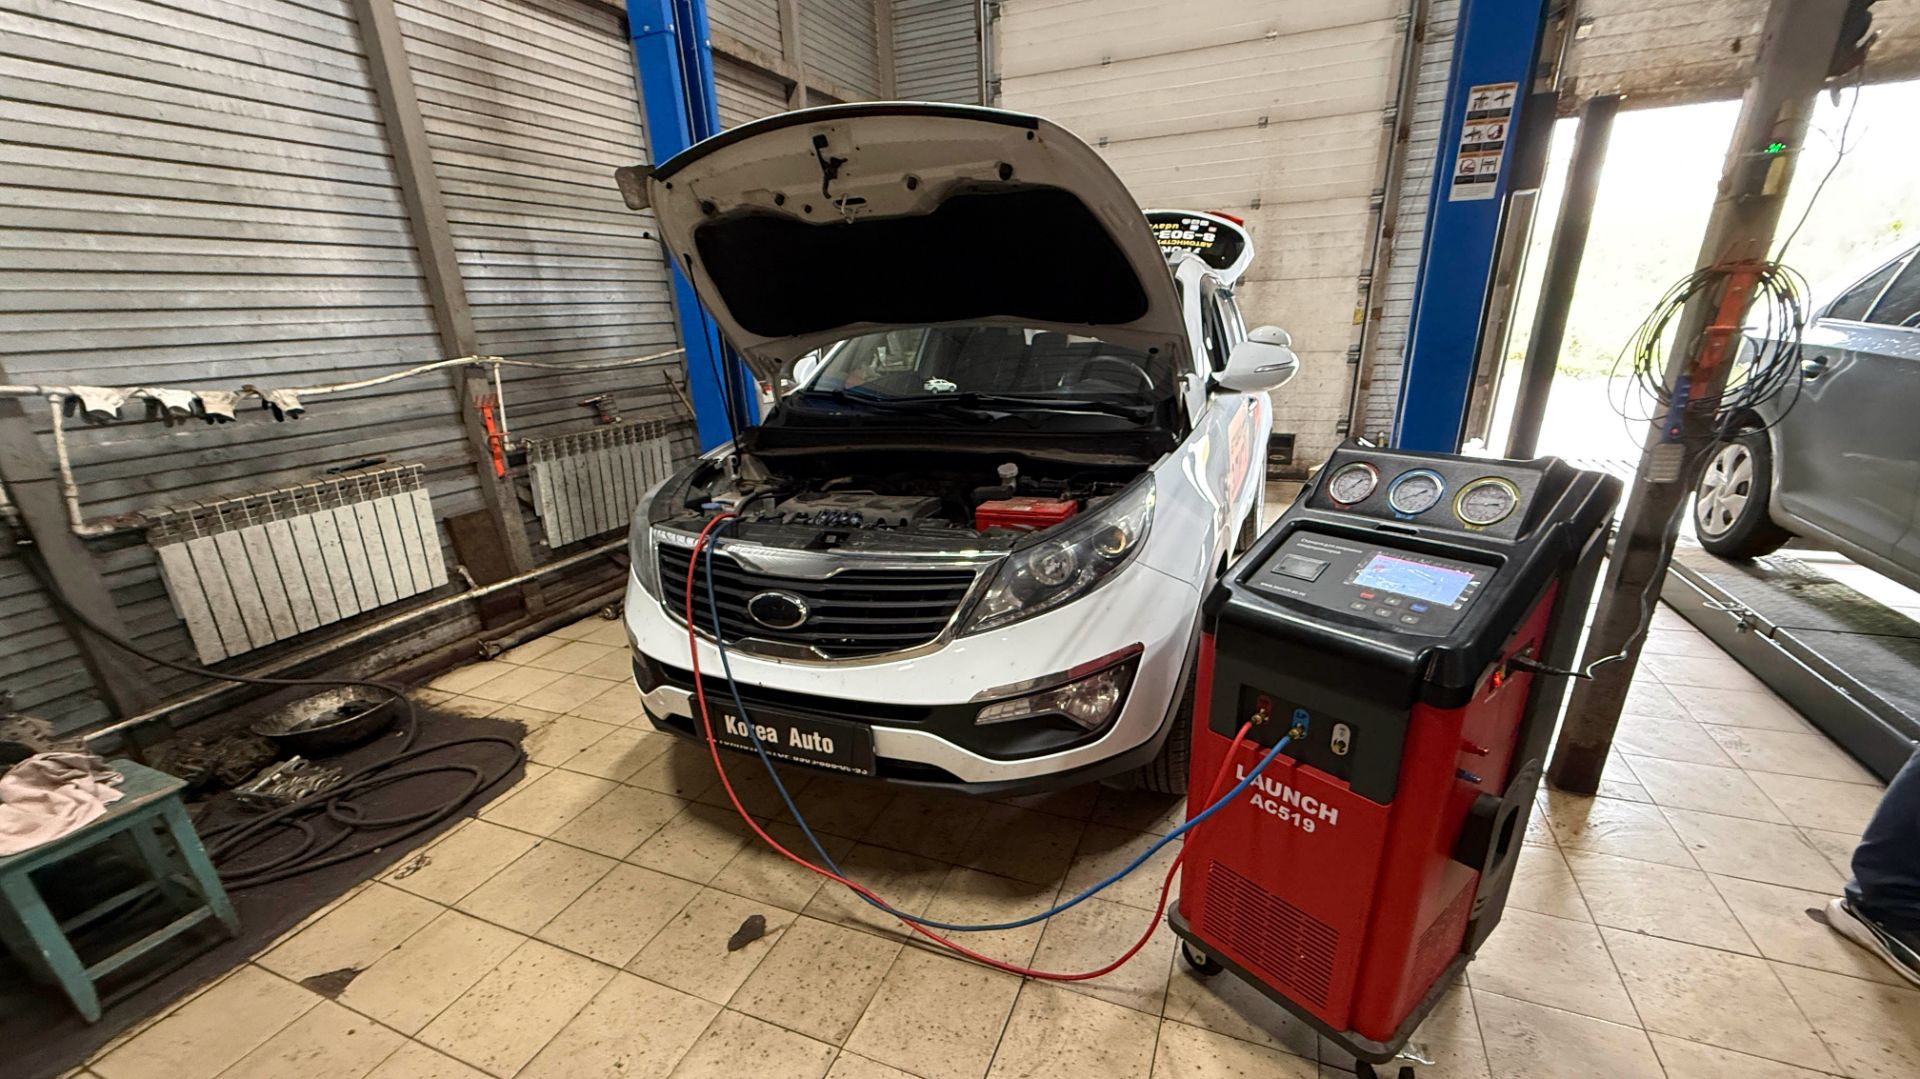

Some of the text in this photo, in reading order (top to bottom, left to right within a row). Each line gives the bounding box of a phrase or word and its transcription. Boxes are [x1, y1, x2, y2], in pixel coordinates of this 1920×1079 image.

[724, 714, 778, 743] Koea
[789, 727, 834, 754] Auto
[1236, 764, 1339, 825] LAUNCH
[1250, 793, 1316, 833] AC519
